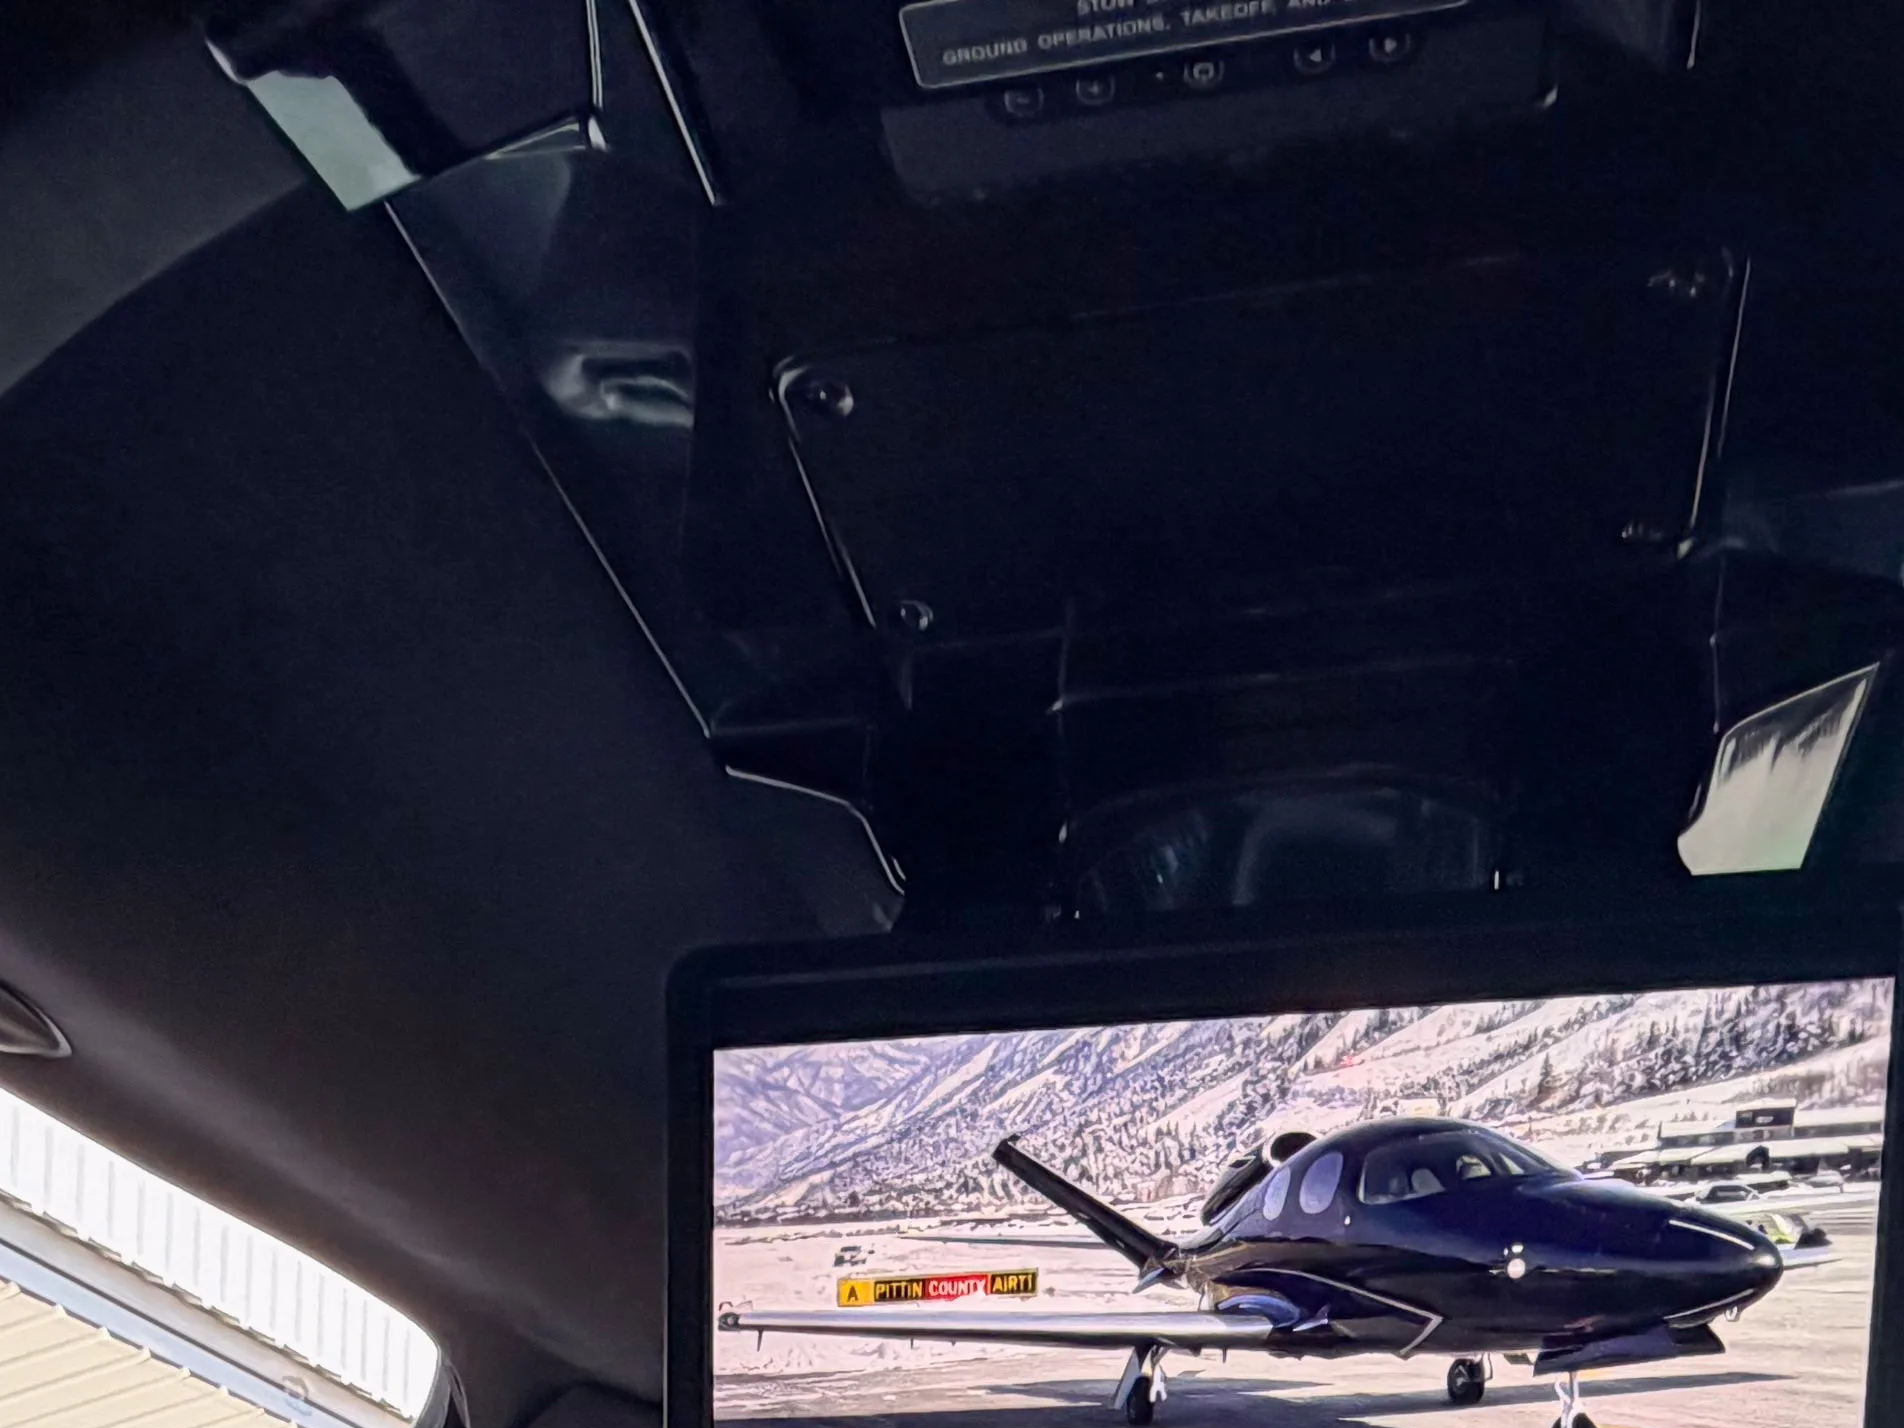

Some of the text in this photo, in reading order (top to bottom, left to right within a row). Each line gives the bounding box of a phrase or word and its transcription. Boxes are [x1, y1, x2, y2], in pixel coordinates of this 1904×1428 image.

[943, 37, 1028, 65] GROUND
[847, 1285, 859, 1301] A
[928, 1278, 986, 1296] COUNTY
